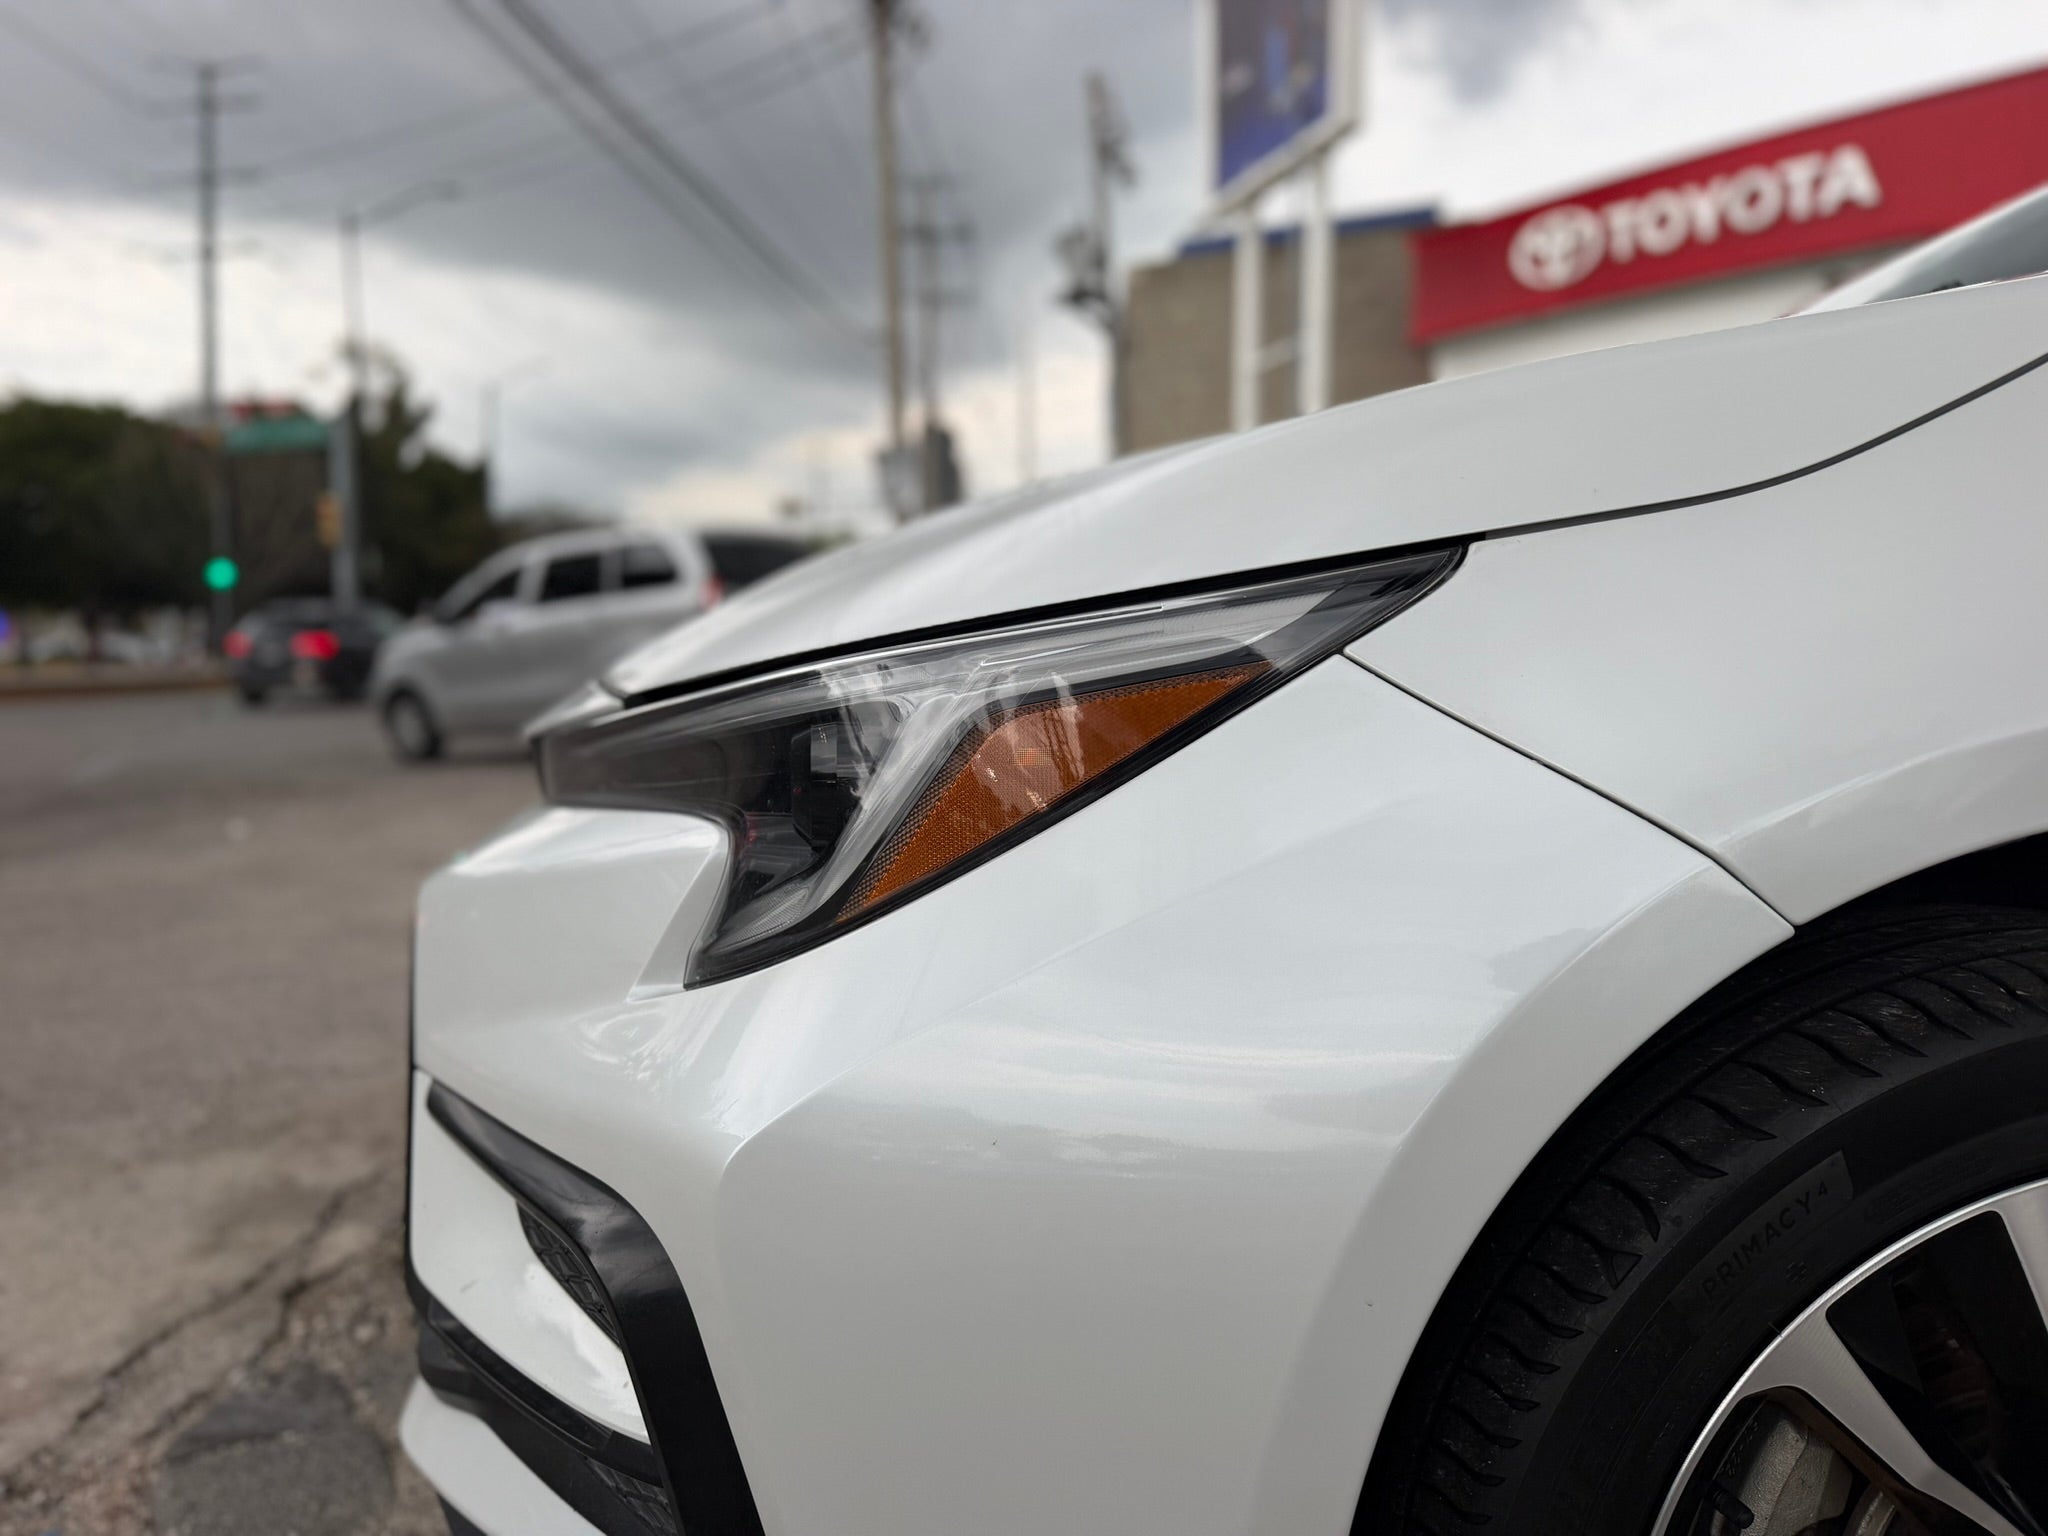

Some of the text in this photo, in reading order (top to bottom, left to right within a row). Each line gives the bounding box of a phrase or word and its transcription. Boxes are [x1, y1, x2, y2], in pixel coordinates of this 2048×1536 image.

[1604, 144, 1881, 262] TOYOTA
[1702, 1191, 1813, 1300] PRIMACY
[1817, 1181, 1828, 1198] 4
